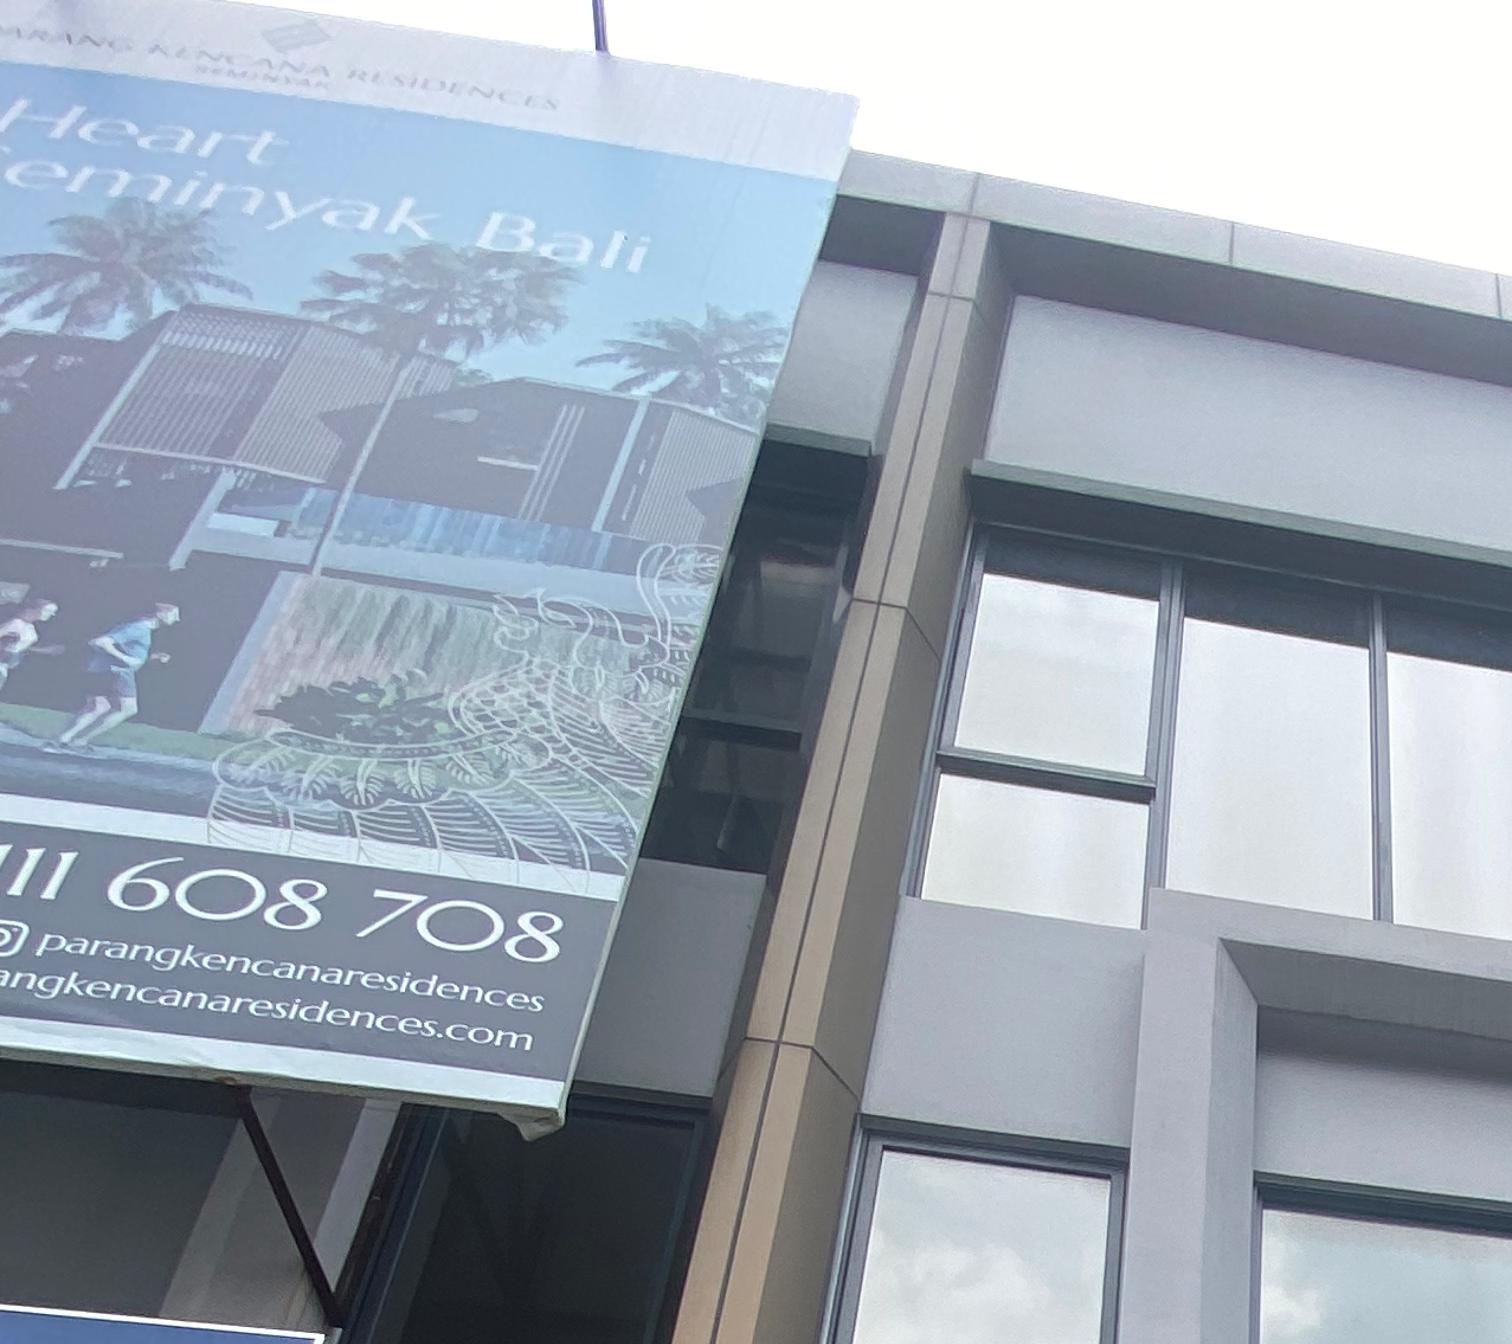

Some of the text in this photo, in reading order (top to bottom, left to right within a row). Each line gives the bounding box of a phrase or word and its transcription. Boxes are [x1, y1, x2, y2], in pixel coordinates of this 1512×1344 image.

[347, 67, 560, 111] RESIDENCES
[0, 98, 290, 165] Heart
[0, 147, 652, 274] eminyak Bali
[107, 856, 328, 931] 608
[355, 888, 564, 963] 708
[35, 933, 545, 1012] parangkencanaresidences
